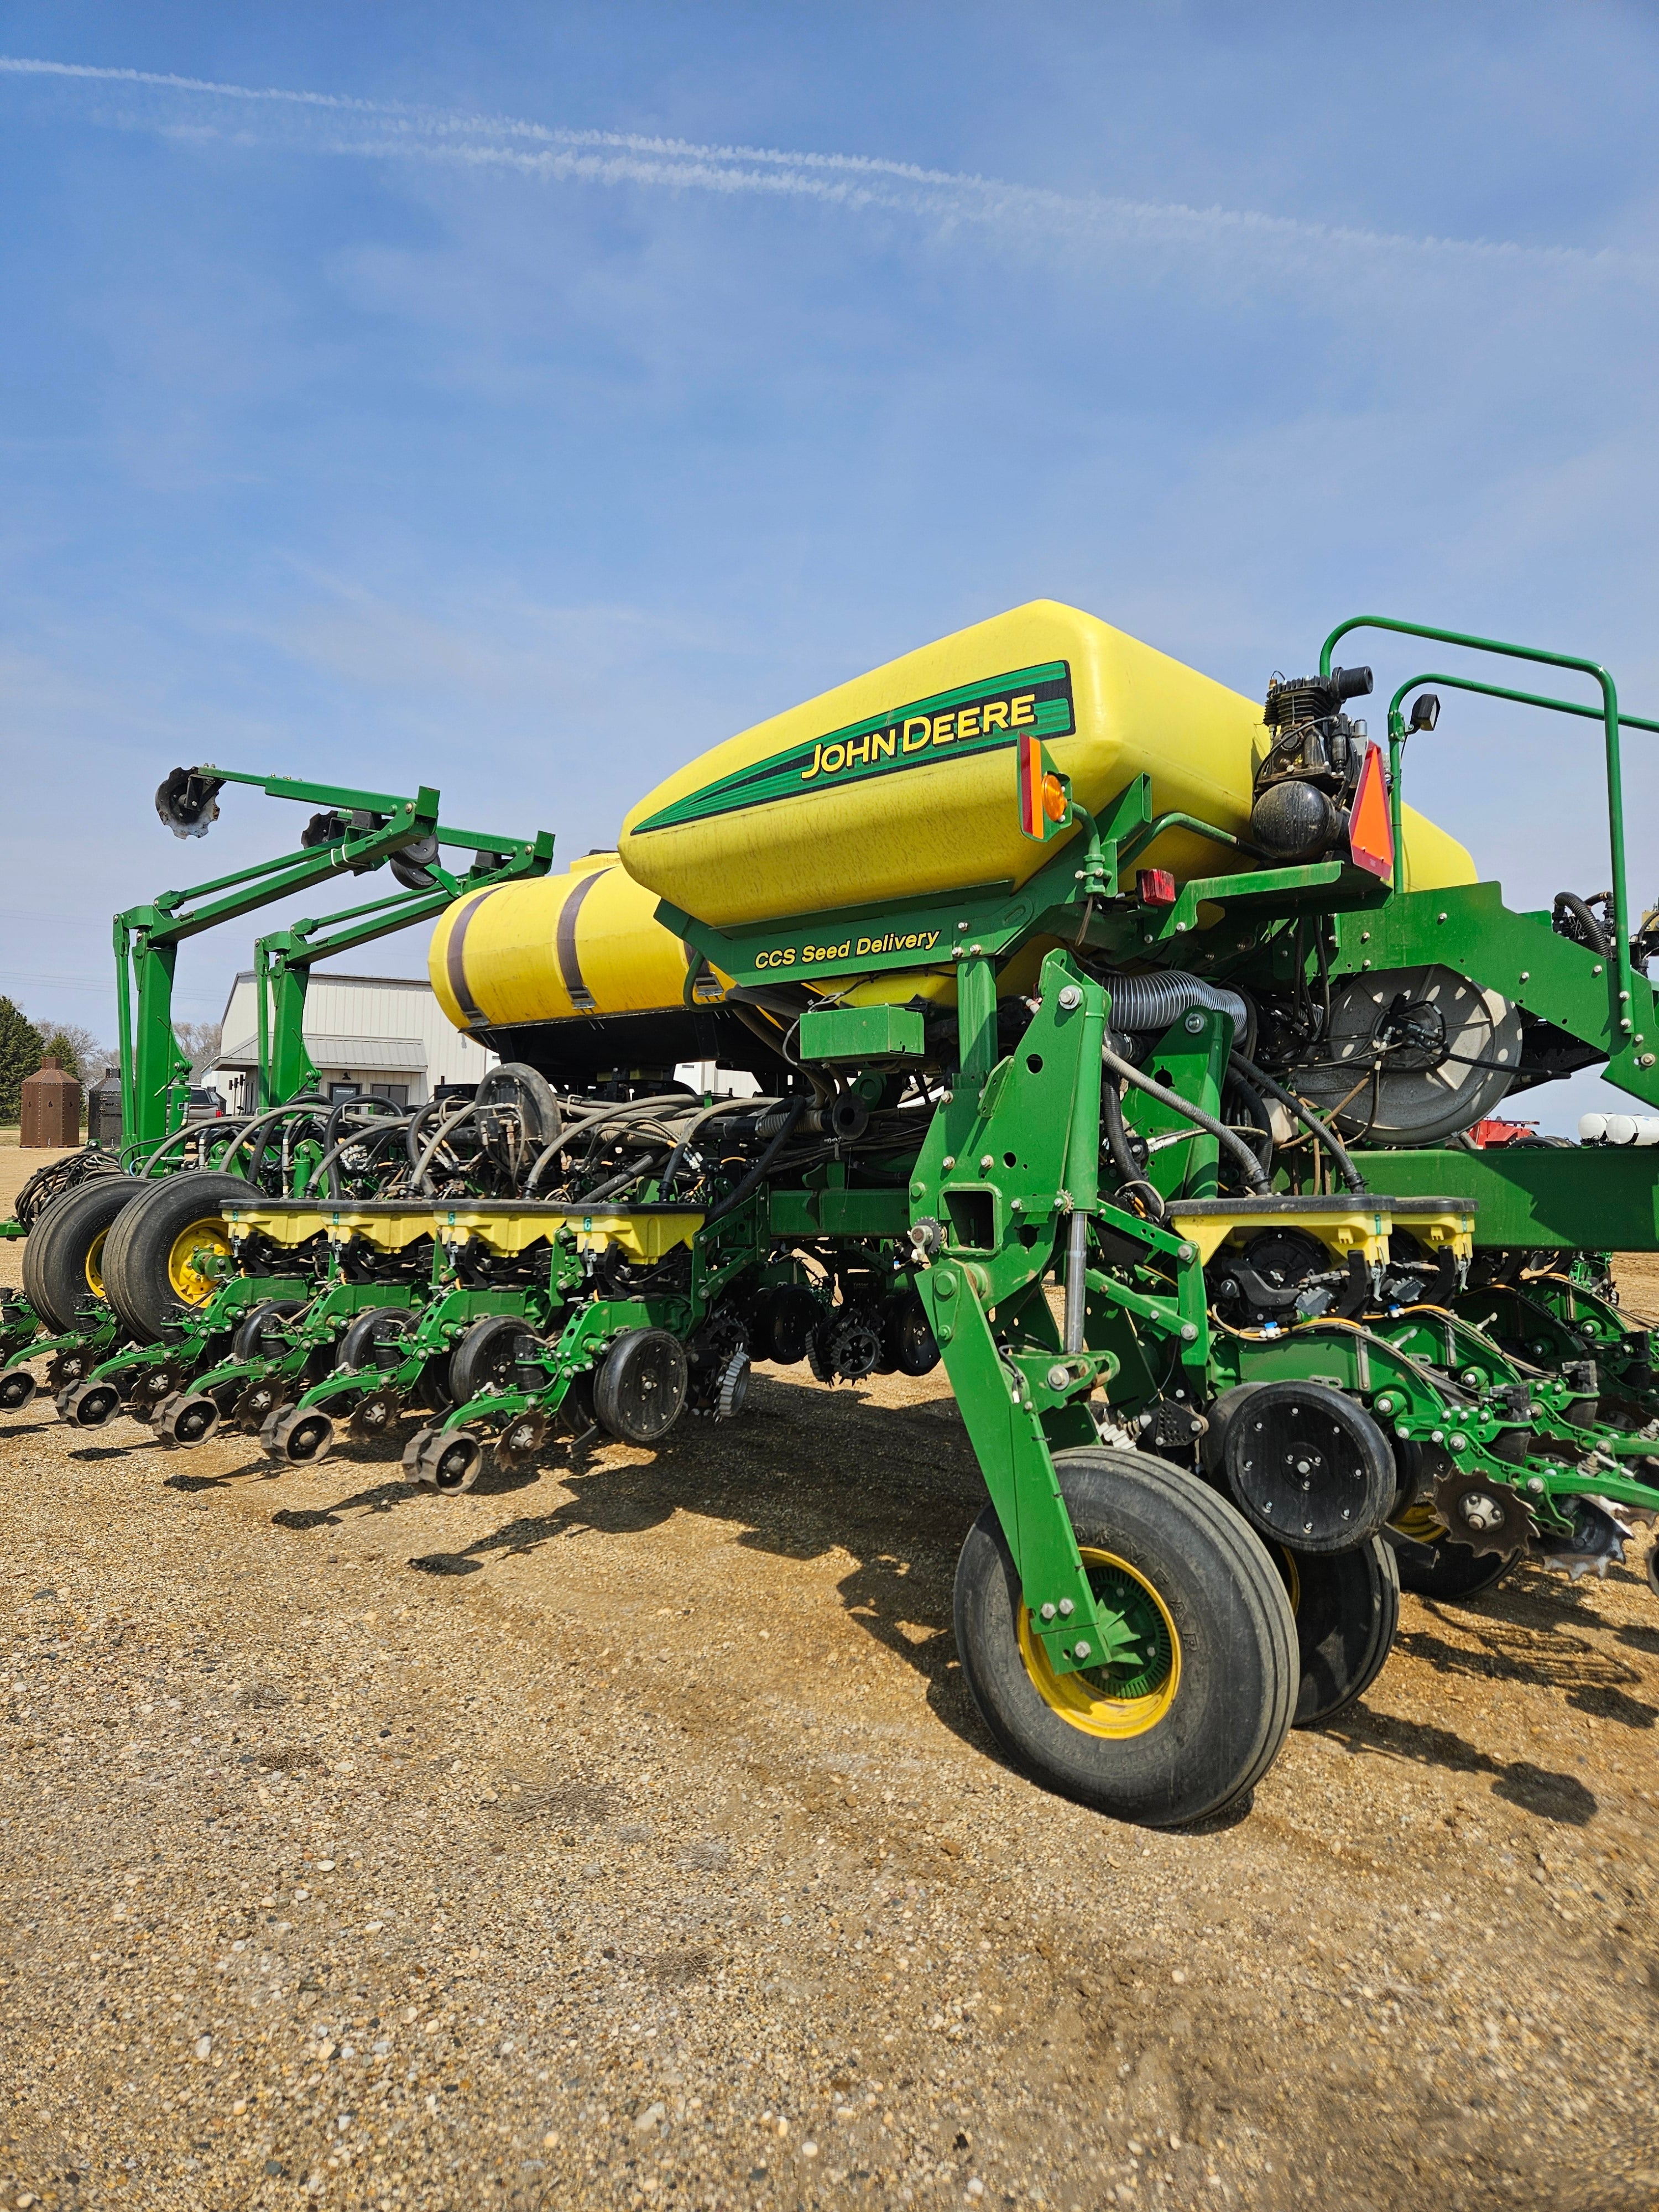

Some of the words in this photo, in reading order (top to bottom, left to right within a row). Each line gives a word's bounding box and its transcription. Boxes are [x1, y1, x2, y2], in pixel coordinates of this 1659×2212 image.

[801, 729, 895, 779] JOHN
[902, 694, 1035, 753] DEERE
[755, 948, 796, 969] CCS
[801, 940, 851, 963] Seed
[856, 931, 940, 955] Delivery
[233, 1211, 237, 1220] 3
[333, 1213, 338, 1223] 4
[448, 1213, 454, 1224] 5
[585, 1218, 591, 1230] 6
[1226, 1282, 1232, 1291] 7
